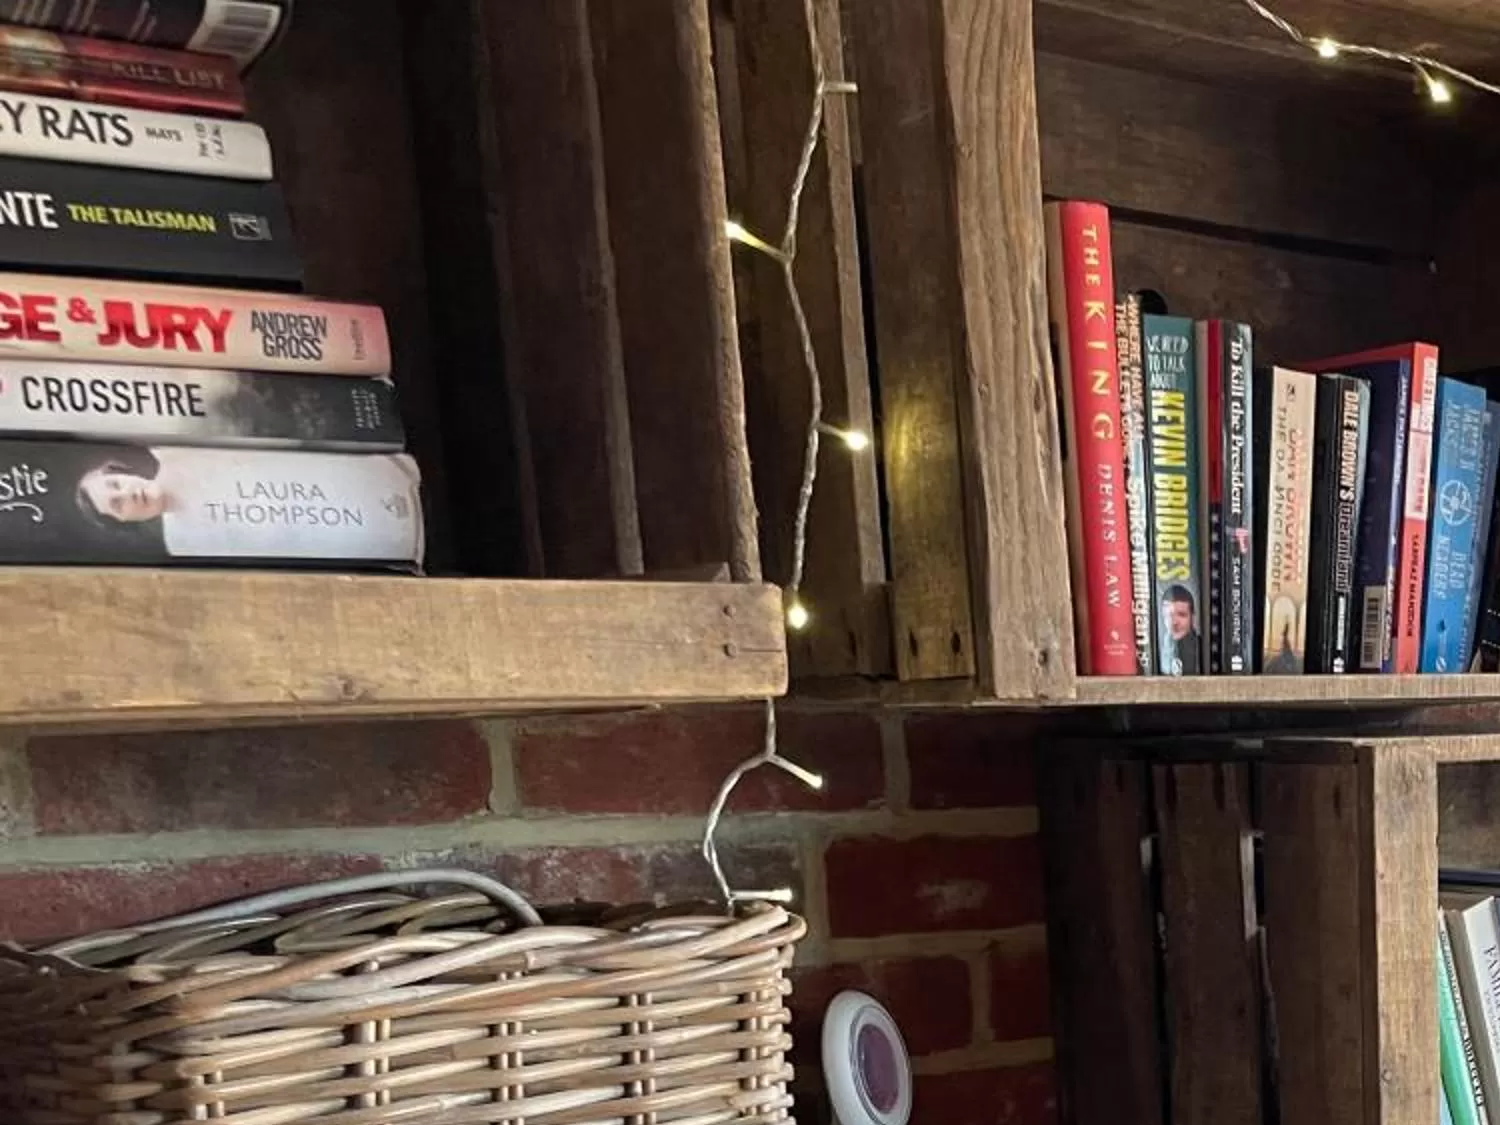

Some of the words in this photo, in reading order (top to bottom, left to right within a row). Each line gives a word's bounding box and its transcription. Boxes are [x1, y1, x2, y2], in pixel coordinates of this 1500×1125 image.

[40, 104, 134, 147] RATS
[67, 204, 107, 225] THE
[111, 206, 217, 235] TALISMAN
[1081, 223, 1102, 288] THE
[66, 296, 98, 327] &
[95, 301, 234, 355] JURY
[250, 310, 328, 340] ANDREW
[1114, 302, 1128, 334] THE
[262, 335, 324, 362] GROSS
[1229, 337, 1244, 361] To
[1083, 300, 1114, 441] KING
[1229, 364, 1245, 398] Kill
[21, 376, 206, 418] CROSSFIRE
[1230, 401, 1244, 431] the
[1342, 389, 1359, 429] DALE
[1151, 389, 1187, 467] KEVIN
[1230, 433, 1245, 515] President
[1339, 430, 1357, 502] BROWN'S
[236, 479, 328, 503] LAURA
[1097, 462, 1118, 544] DENIS
[1124, 477, 1147, 547] Spike
[206, 503, 365, 528] THOMPSON
[1153, 472, 1190, 581] BRIDGES
[1103, 553, 1121, 609] LAW
[1130, 550, 1150, 646] Milligan
